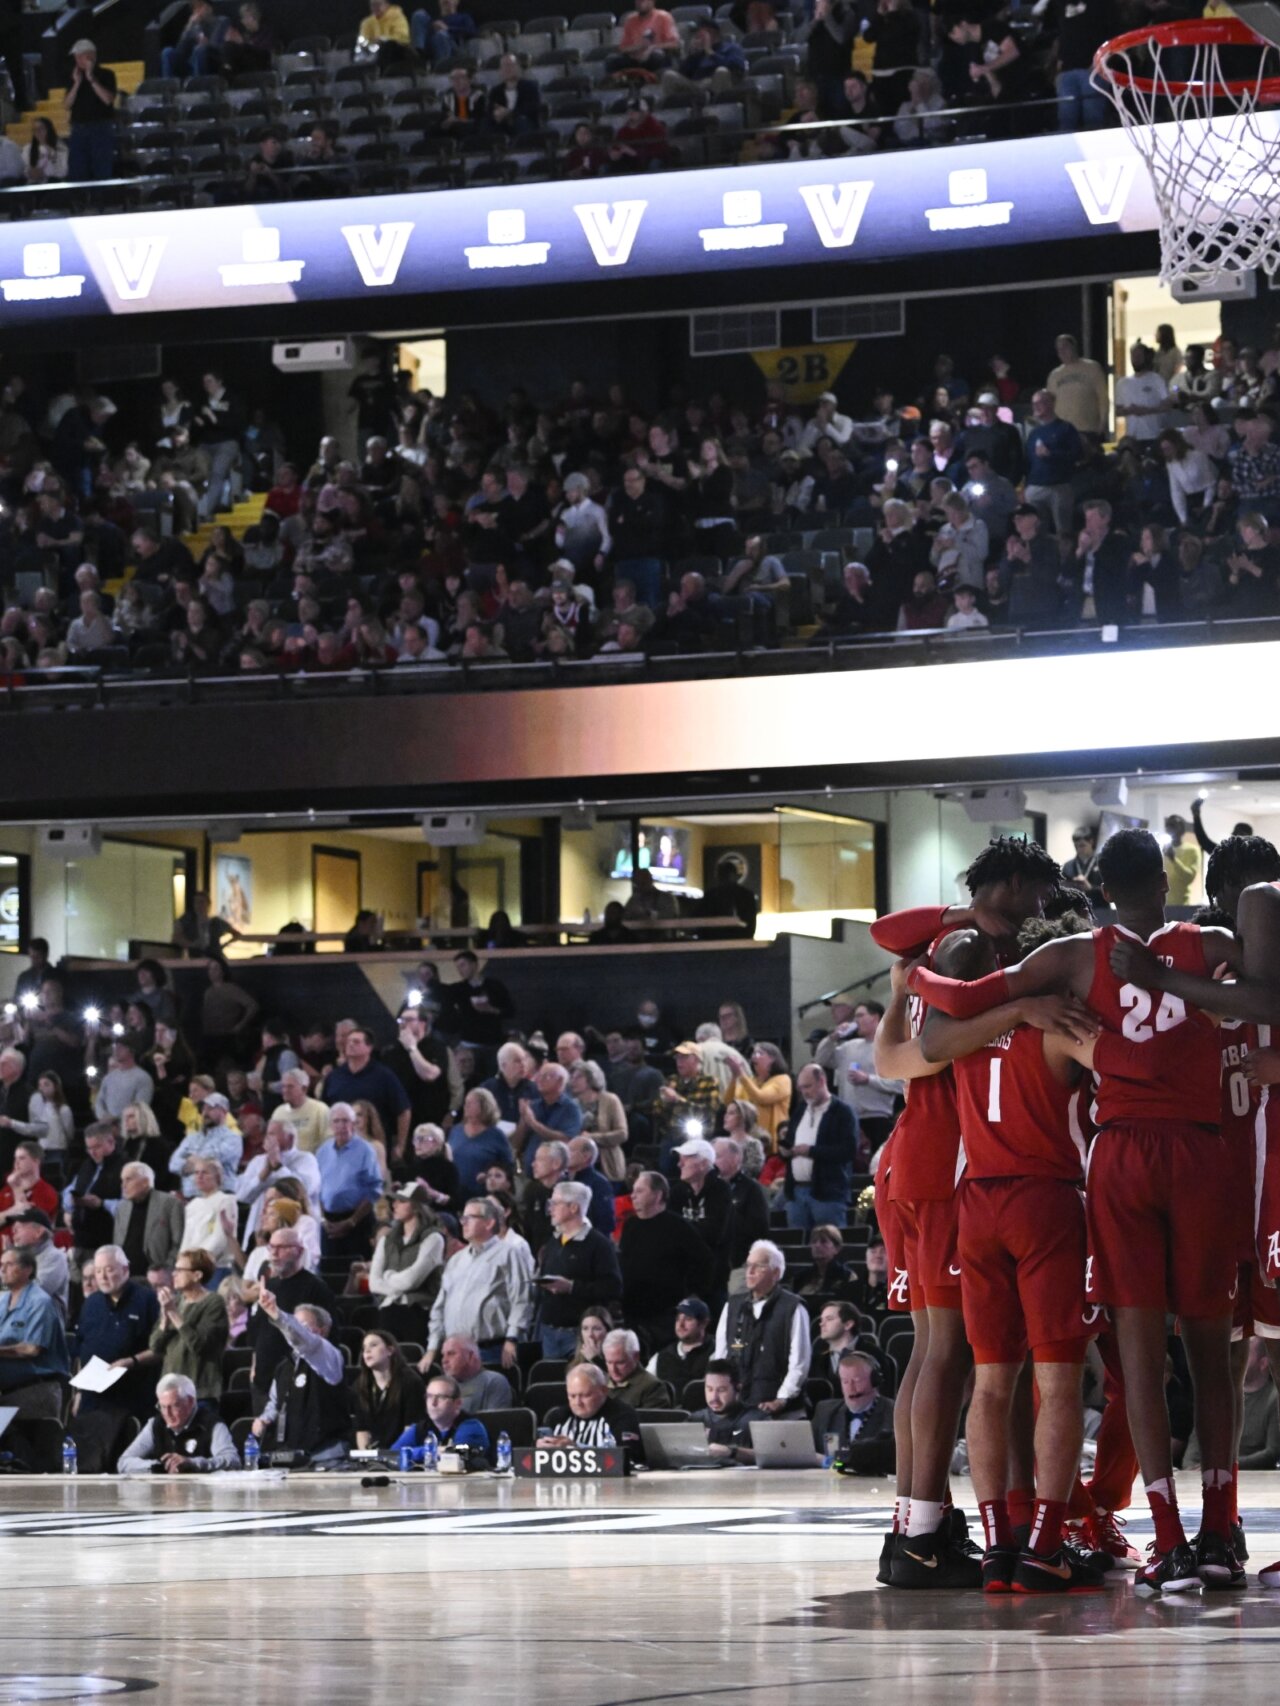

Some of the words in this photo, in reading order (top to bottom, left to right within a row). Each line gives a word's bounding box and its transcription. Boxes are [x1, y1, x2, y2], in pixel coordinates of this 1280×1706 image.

[777, 351, 830, 385] 2B
[1119, 982, 1188, 1043] 24
[988, 1057, 1002, 1122] 1
[887, 1266, 908, 1303] A
[534, 1450, 602, 1474] POSS.
